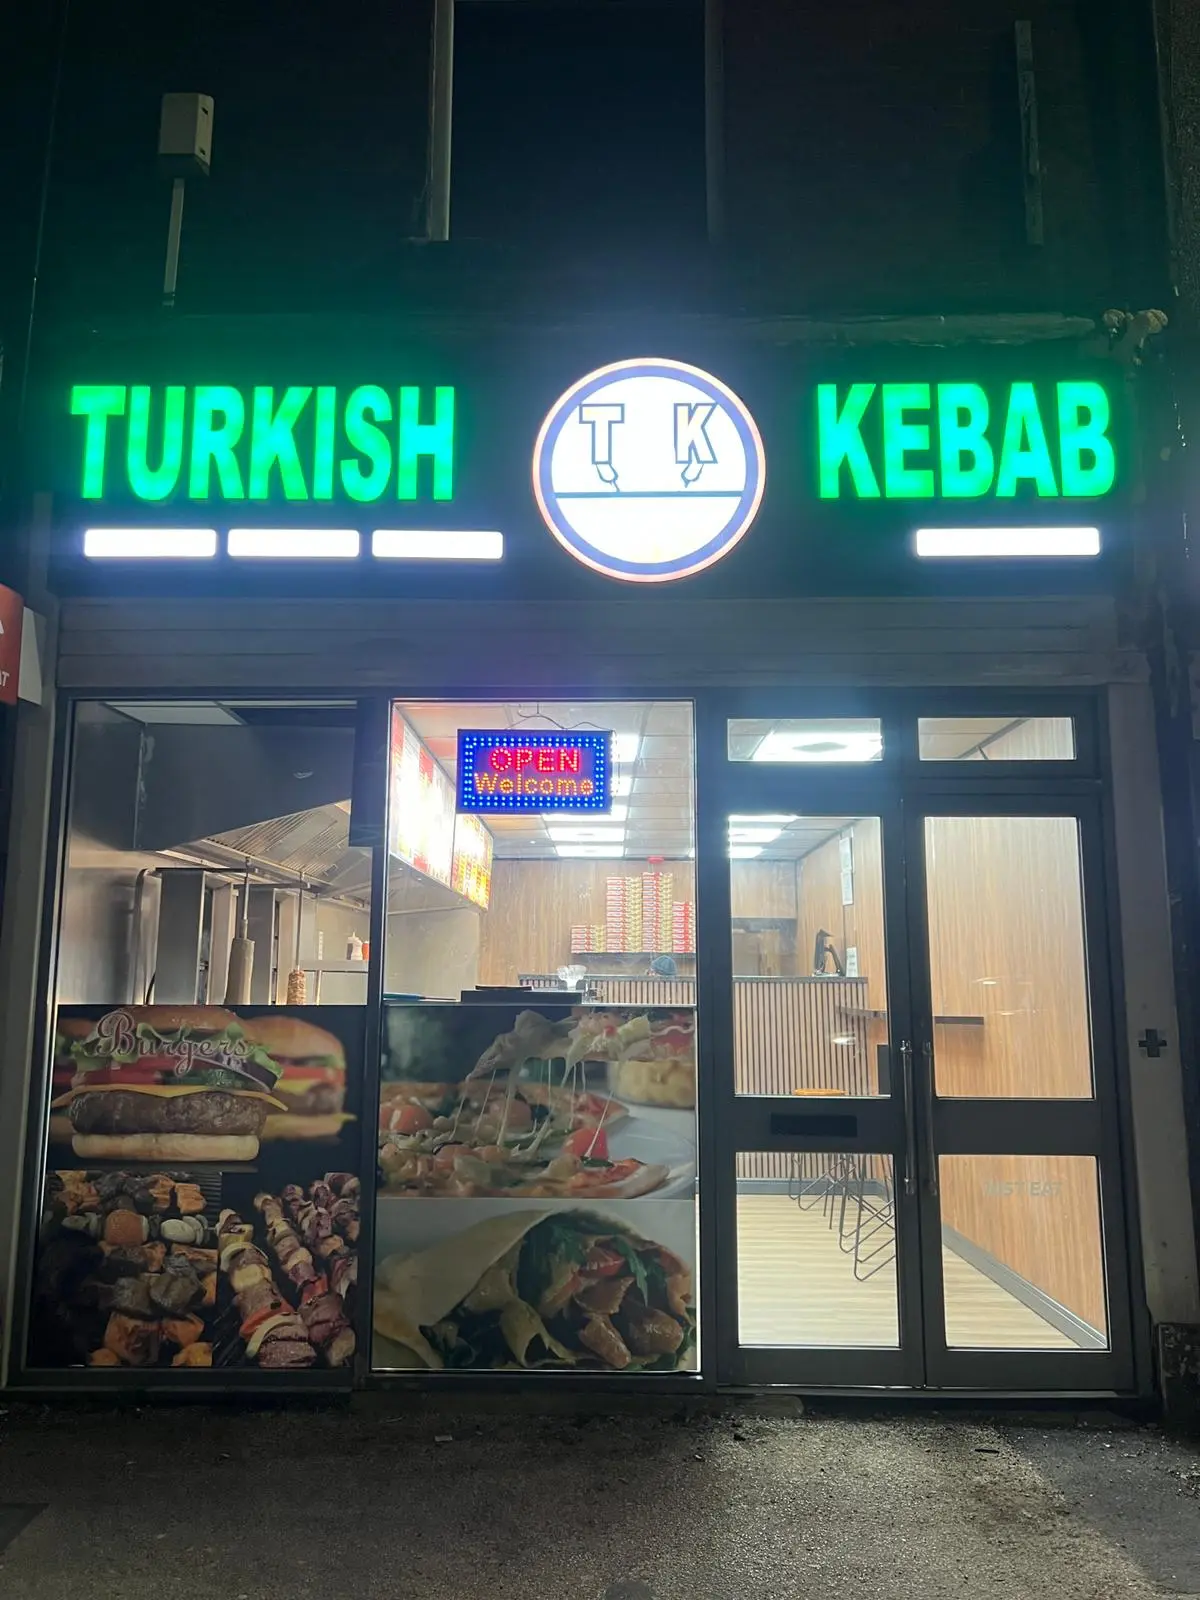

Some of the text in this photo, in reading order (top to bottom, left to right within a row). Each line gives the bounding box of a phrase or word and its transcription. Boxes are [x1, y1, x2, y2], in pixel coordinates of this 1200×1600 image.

[70, 381, 1115, 501] TURKISH KEBAB
[579, 402, 718, 464] T K
[490, 748, 580, 772] OPEN
[474, 773, 593, 795] Welcome
[95, 1011, 252, 1076] Burgers
[1030, 1180, 1063, 1196] EAT
